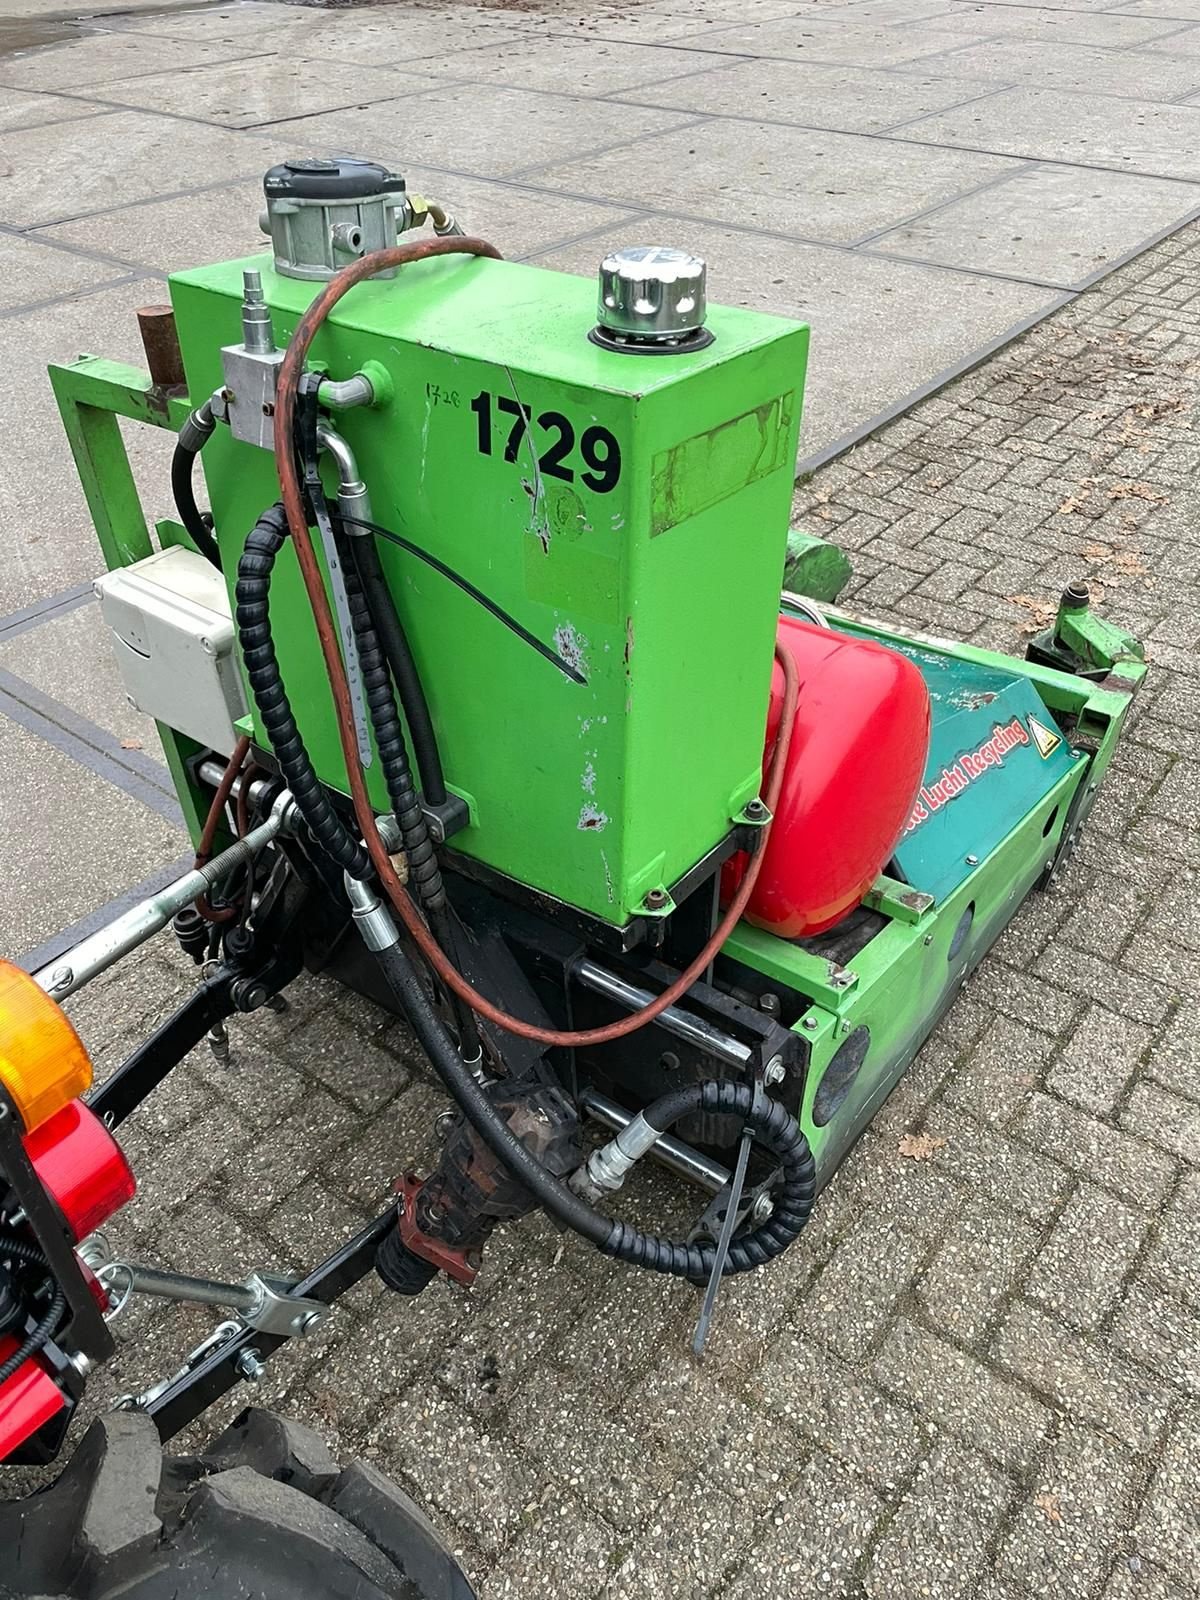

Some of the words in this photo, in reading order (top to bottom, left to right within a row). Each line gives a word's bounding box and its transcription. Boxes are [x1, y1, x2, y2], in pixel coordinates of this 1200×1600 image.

[471, 391, 621, 493] 1729
[920, 764, 969, 811] Lucht
[960, 720, 1029, 779] Recycling
